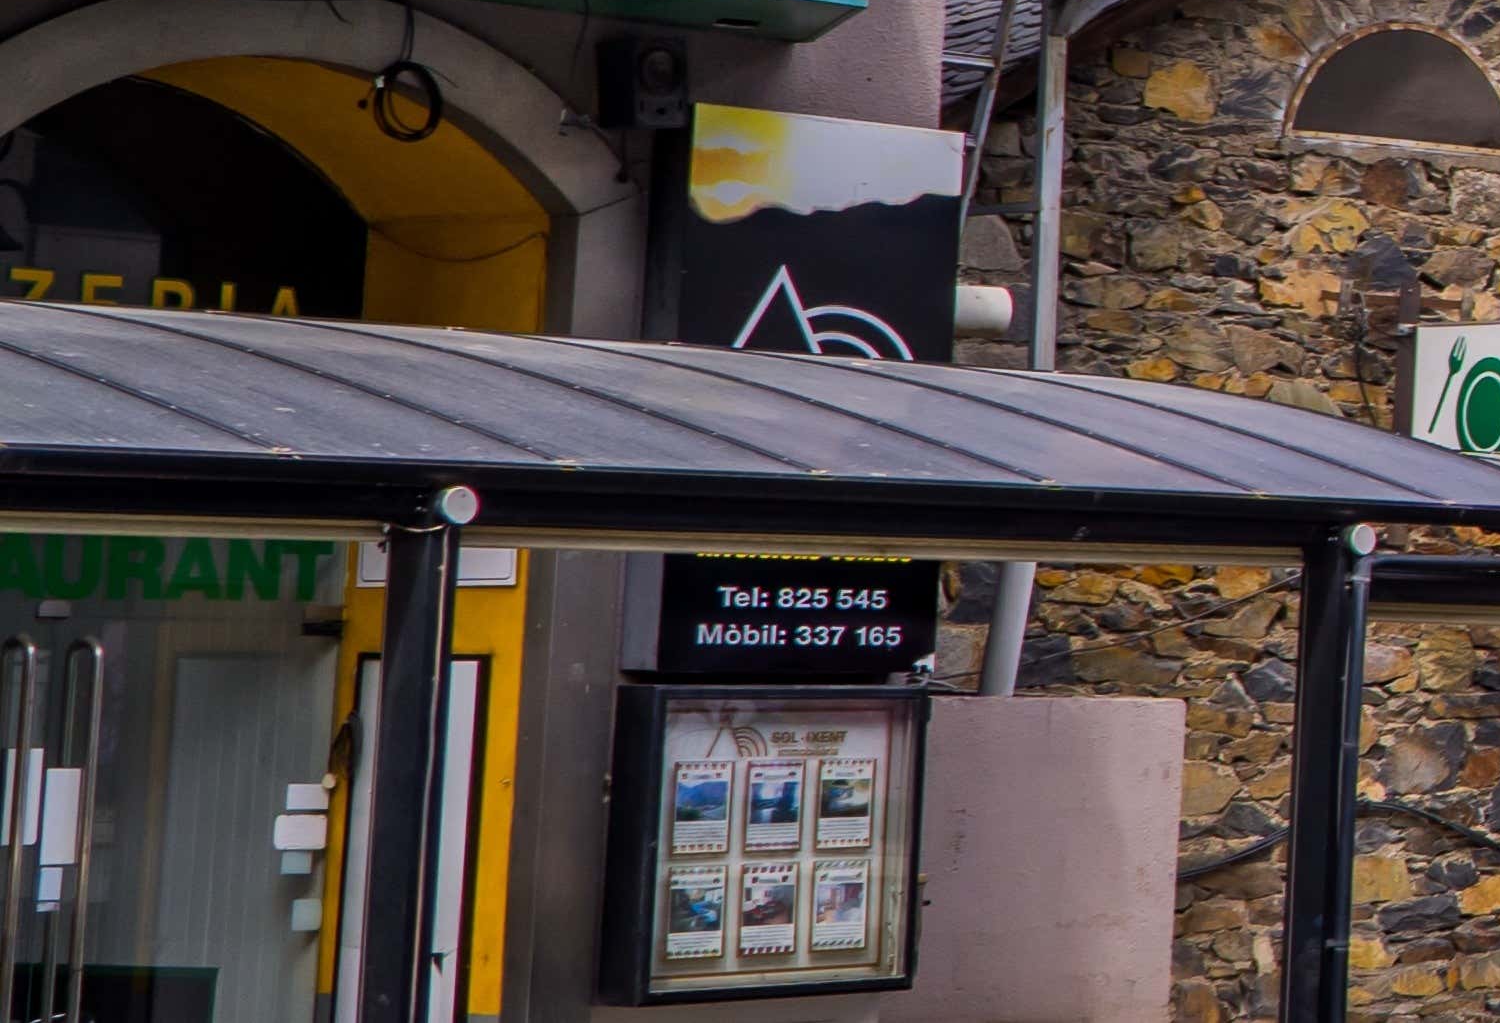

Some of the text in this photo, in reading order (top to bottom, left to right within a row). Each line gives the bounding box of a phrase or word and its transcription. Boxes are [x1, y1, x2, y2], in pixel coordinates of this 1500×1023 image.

[717, 586, 888, 609] Tel: 825 545
[696, 623, 902, 646] Mòbil: 337 165
